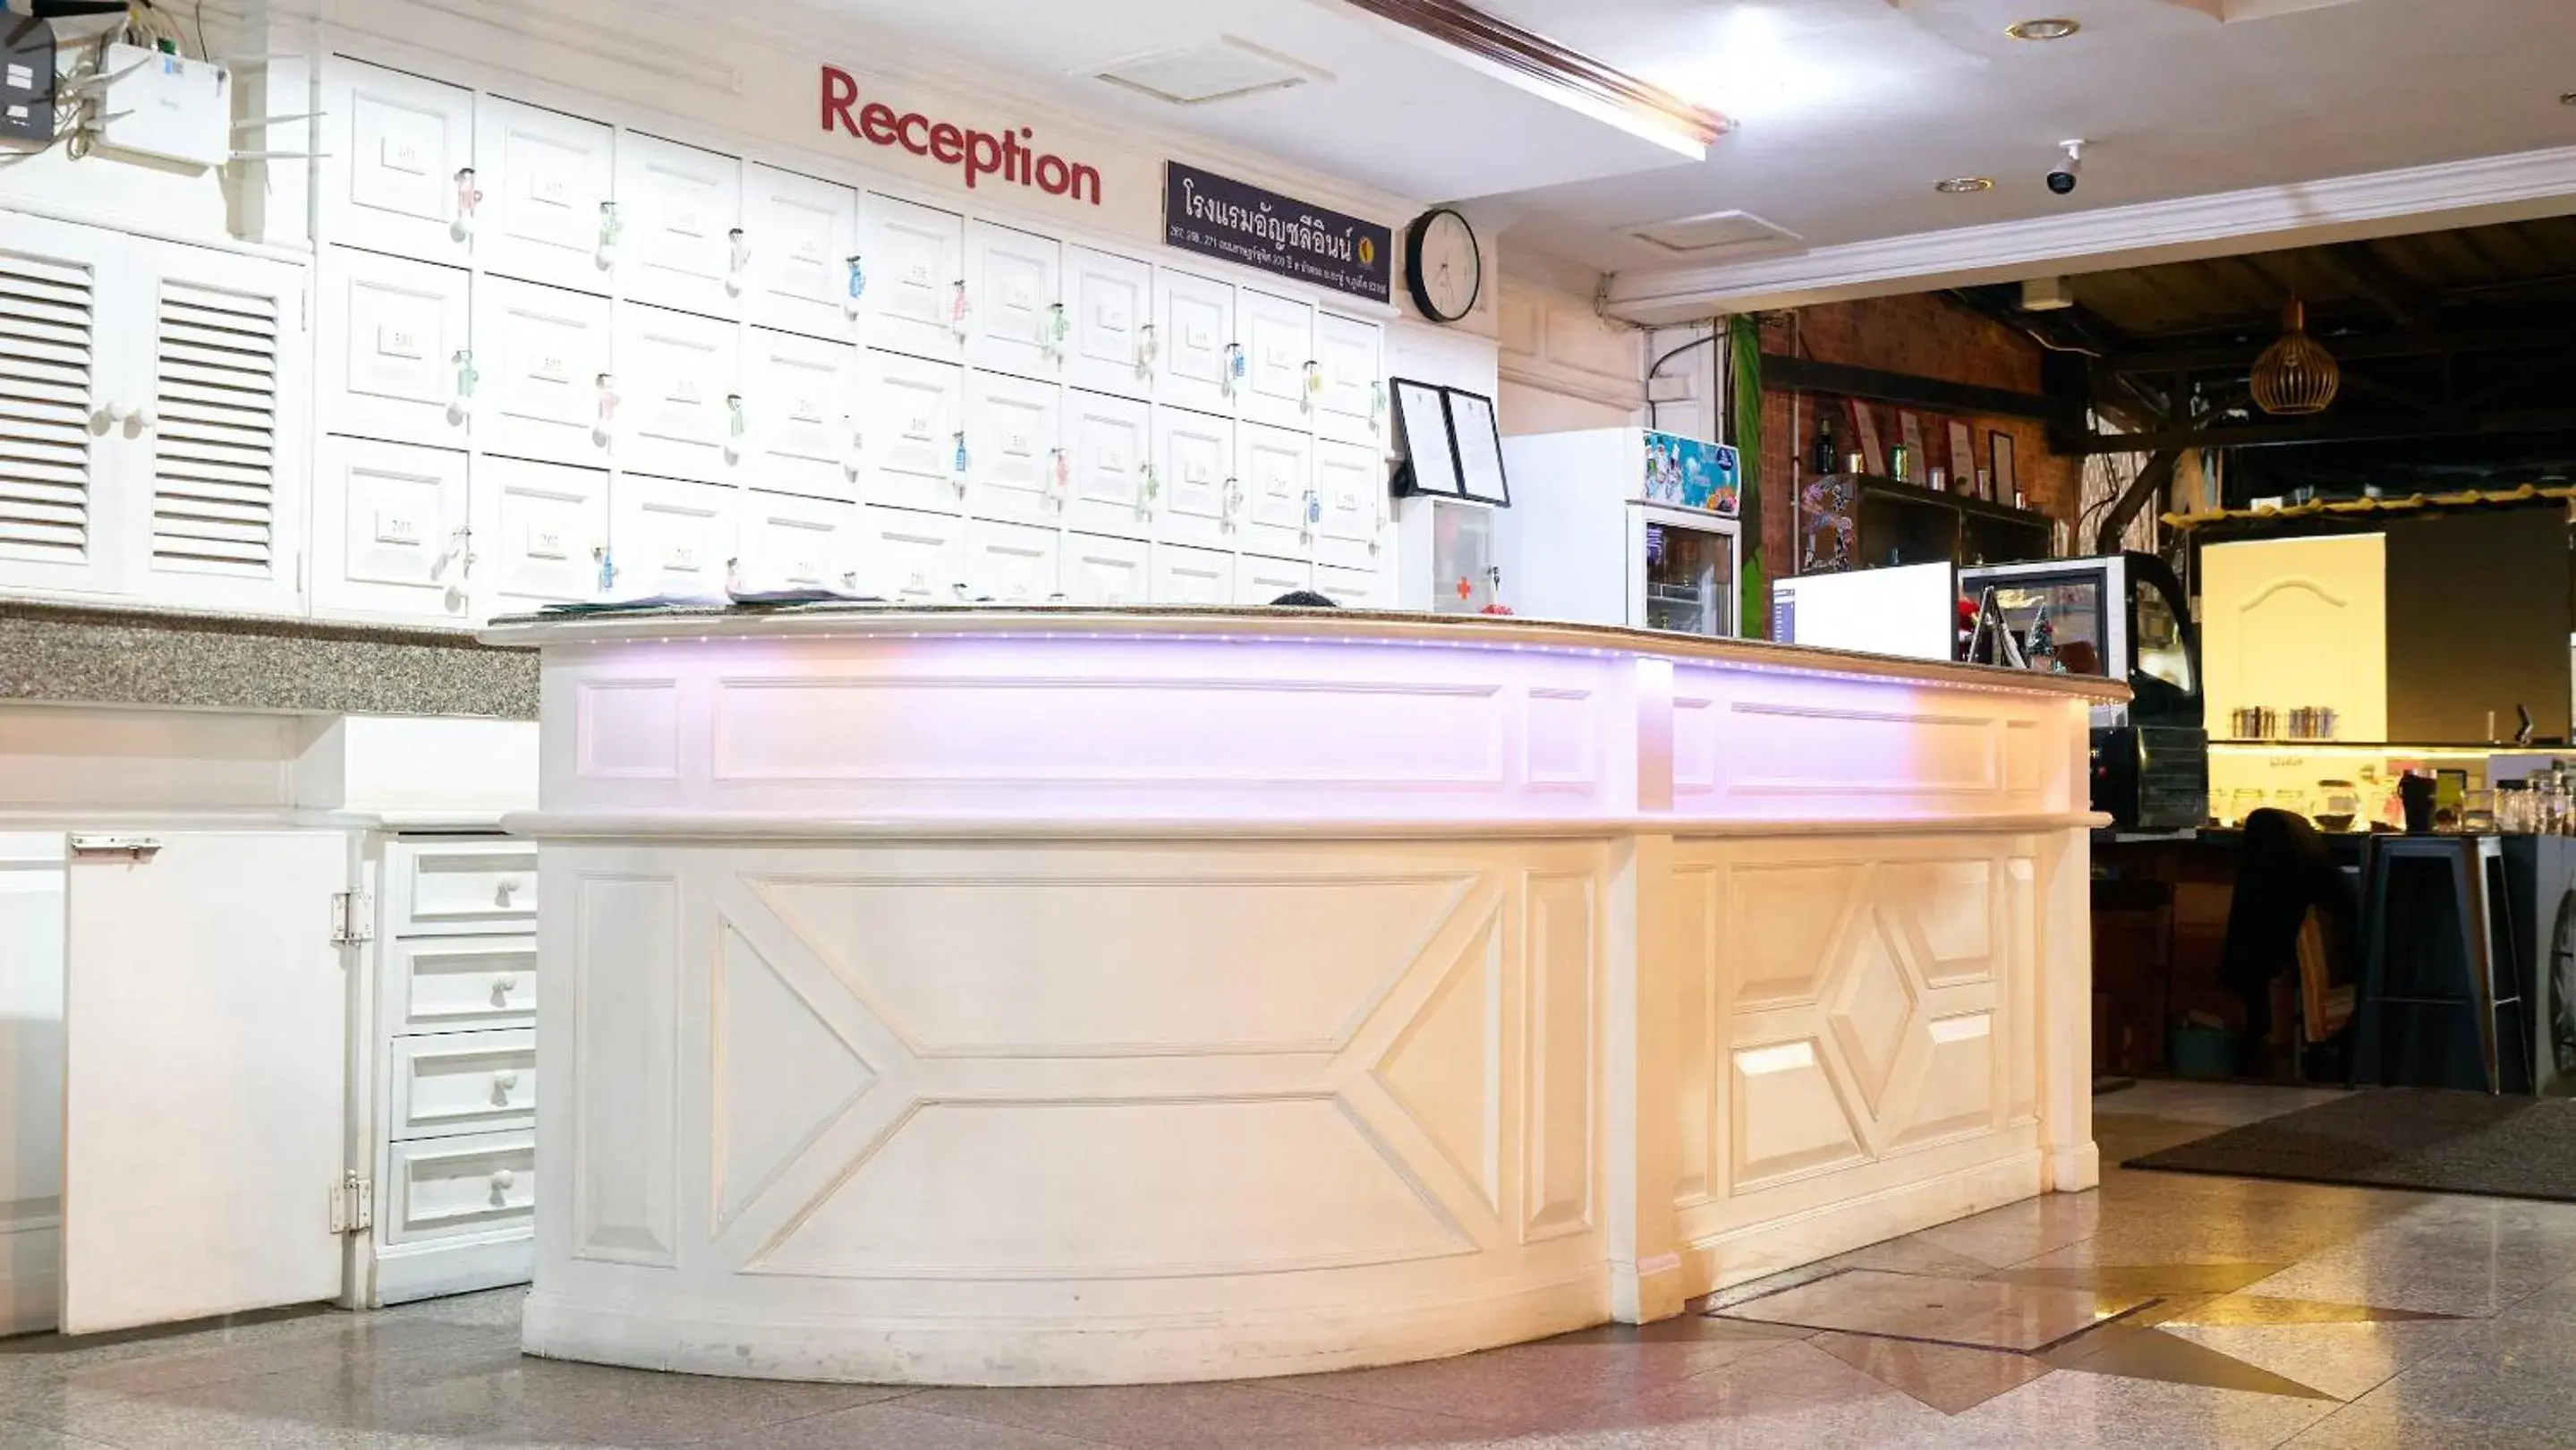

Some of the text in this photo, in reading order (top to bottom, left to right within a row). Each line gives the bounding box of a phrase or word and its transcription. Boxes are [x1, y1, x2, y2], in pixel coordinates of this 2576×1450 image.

[821, 65, 1101, 205] Reception
[1182, 177, 1354, 262] โรงแรมอัญชลีอินน์
